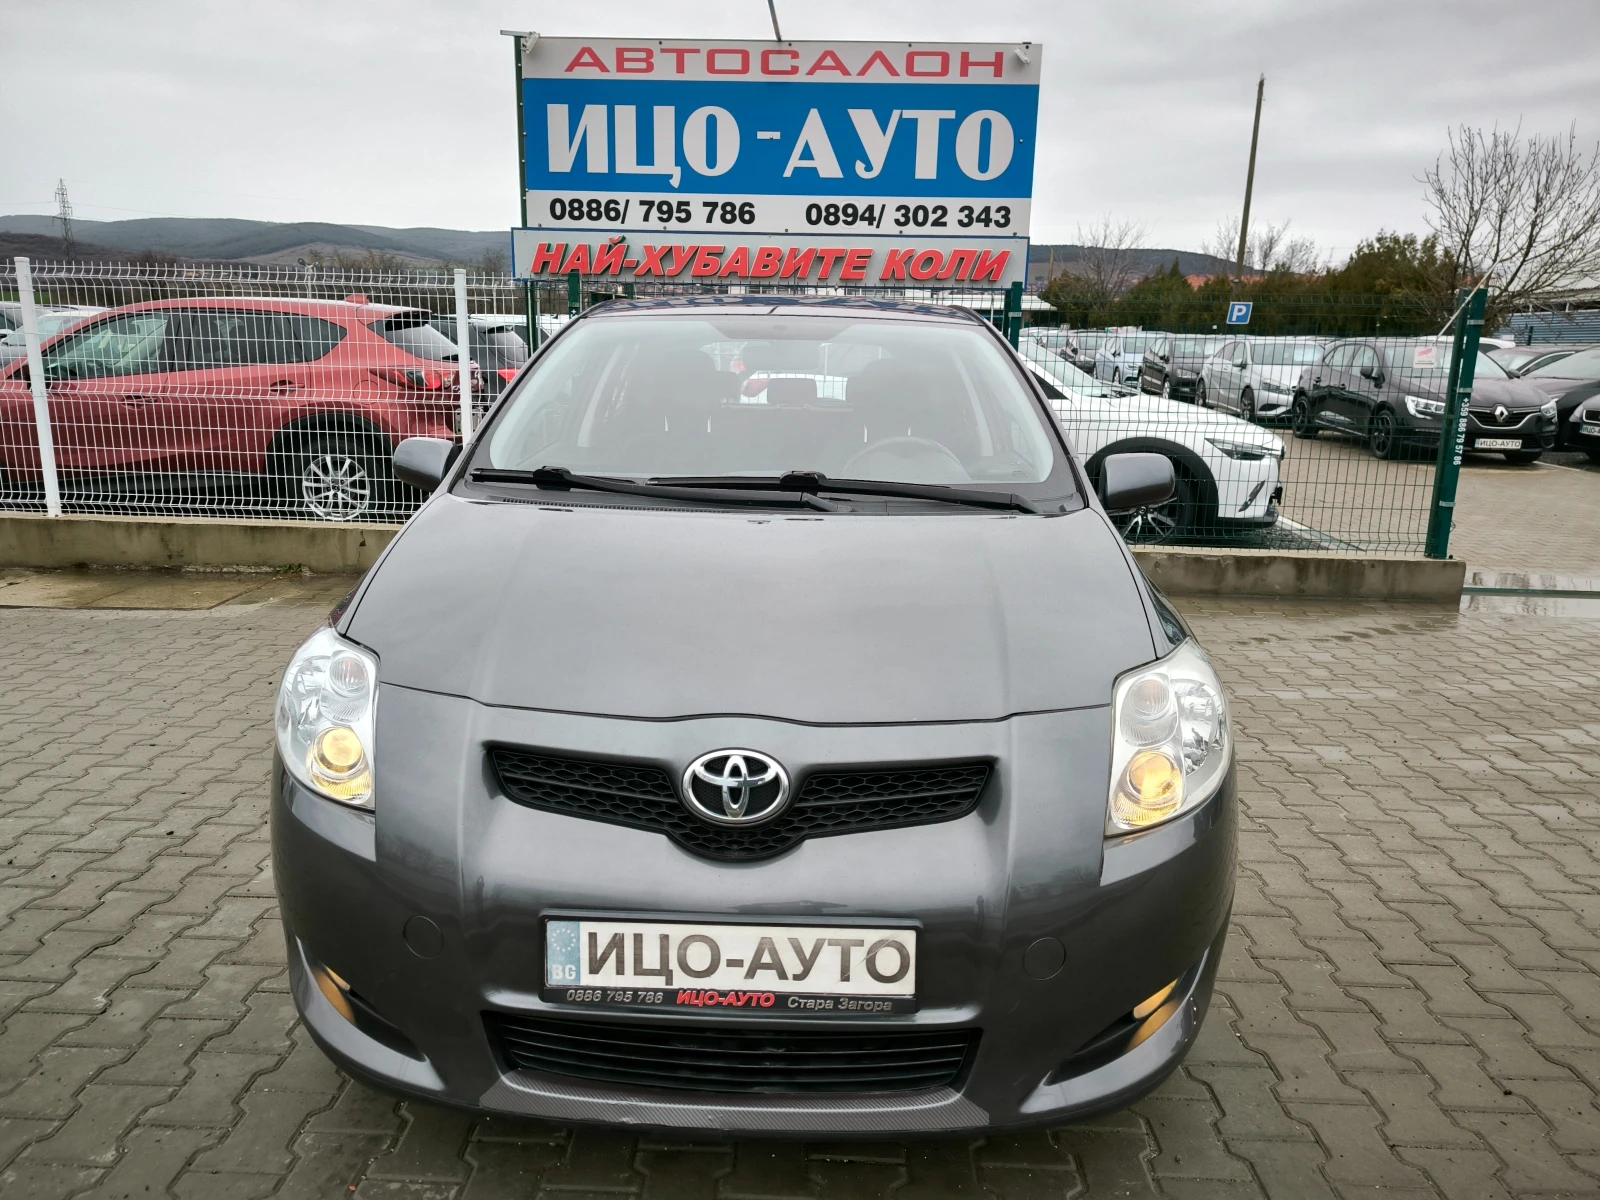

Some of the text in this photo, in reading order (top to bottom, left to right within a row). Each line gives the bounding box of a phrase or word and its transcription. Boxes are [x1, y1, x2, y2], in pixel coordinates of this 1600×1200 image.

[564, 47, 1004, 77] АВТОСАЛОН
[549, 198, 756, 224] 0886/ 795 786
[805, 203, 1012, 229] 0894/ 302 343
[530, 235, 1012, 281] НАЙ-ХУБАВИТЕ КОЛИ
[1231, 304, 1247, 322] P
[1480, 440, 1521, 449] ИЦО-АУТО
[588, 931, 911, 986] ИЦО-АУТО
[551, 964, 576, 980] BG
[566, 989, 664, 1004] 0886 795 786
[676, 989, 775, 1008] ИЦО-АУТО
[787, 996, 892, 1012] Стара Загора
